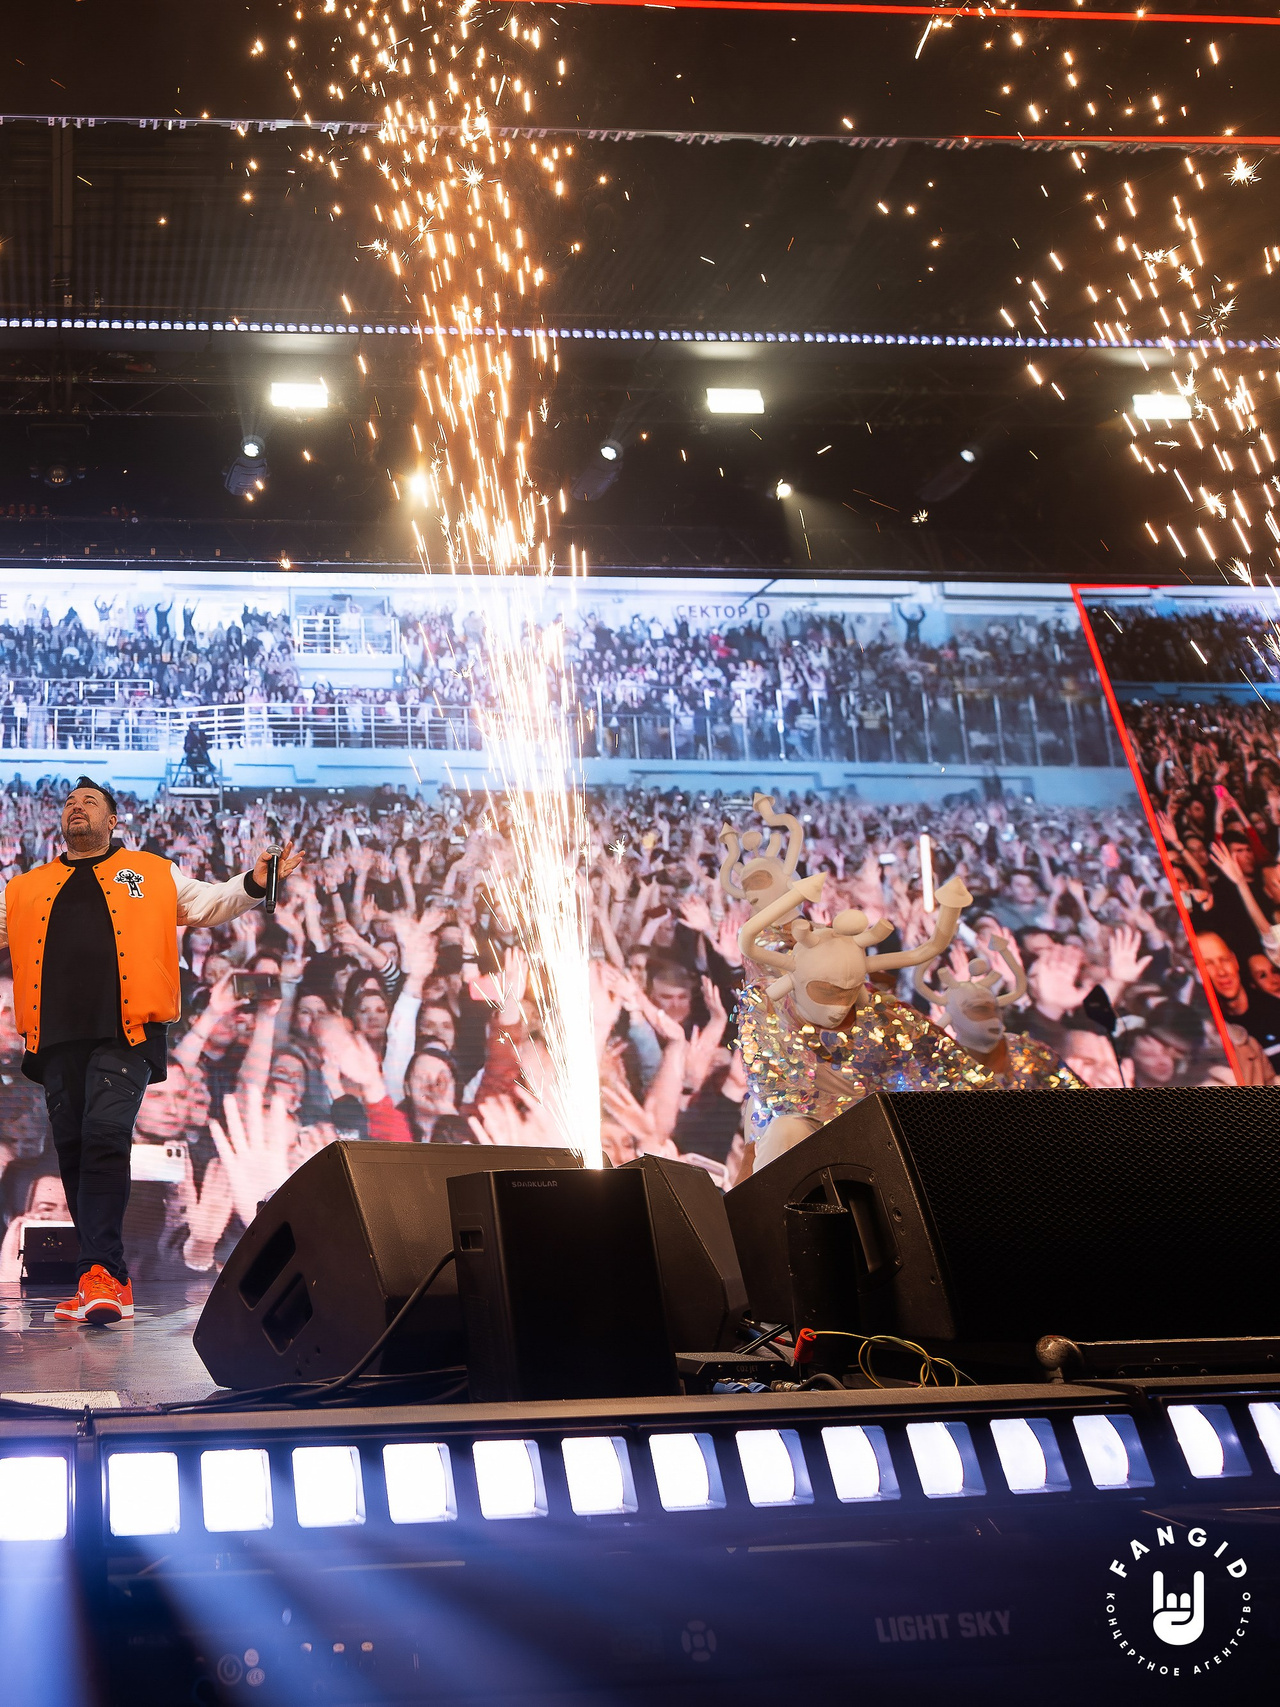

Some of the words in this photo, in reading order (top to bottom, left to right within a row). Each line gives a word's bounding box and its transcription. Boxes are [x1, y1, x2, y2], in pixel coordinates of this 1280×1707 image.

[756, 602, 770, 619] D
[874, 1612, 949, 1643] LIGHT
[958, 1609, 1011, 1638] SKY
